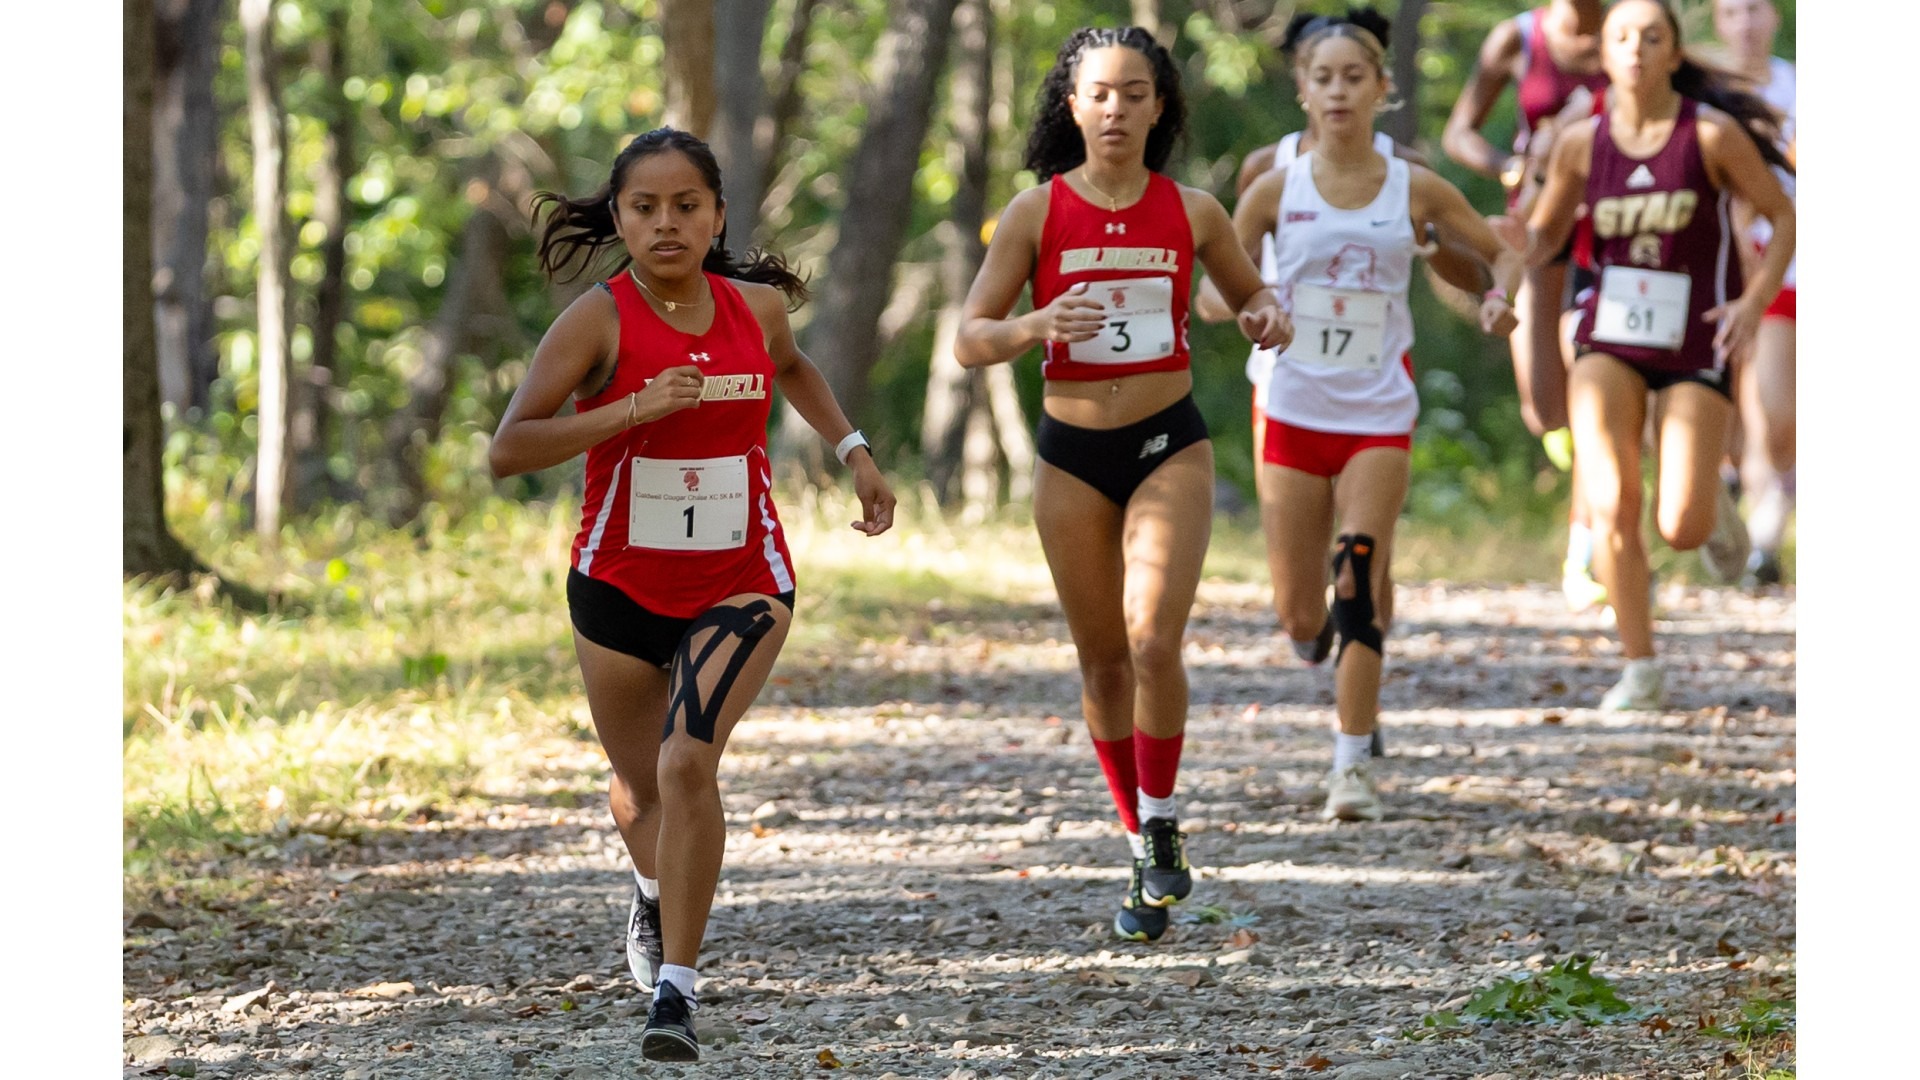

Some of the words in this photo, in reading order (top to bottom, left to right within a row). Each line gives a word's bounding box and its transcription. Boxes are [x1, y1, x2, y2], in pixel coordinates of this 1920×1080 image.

[1594, 188, 1697, 238] STAC
[1626, 307, 1653, 332] 61
[1109, 321, 1131, 352] 3
[1320, 328, 1353, 355] 17
[663, 493, 686, 502] Cougar
[683, 504, 695, 538] 1
